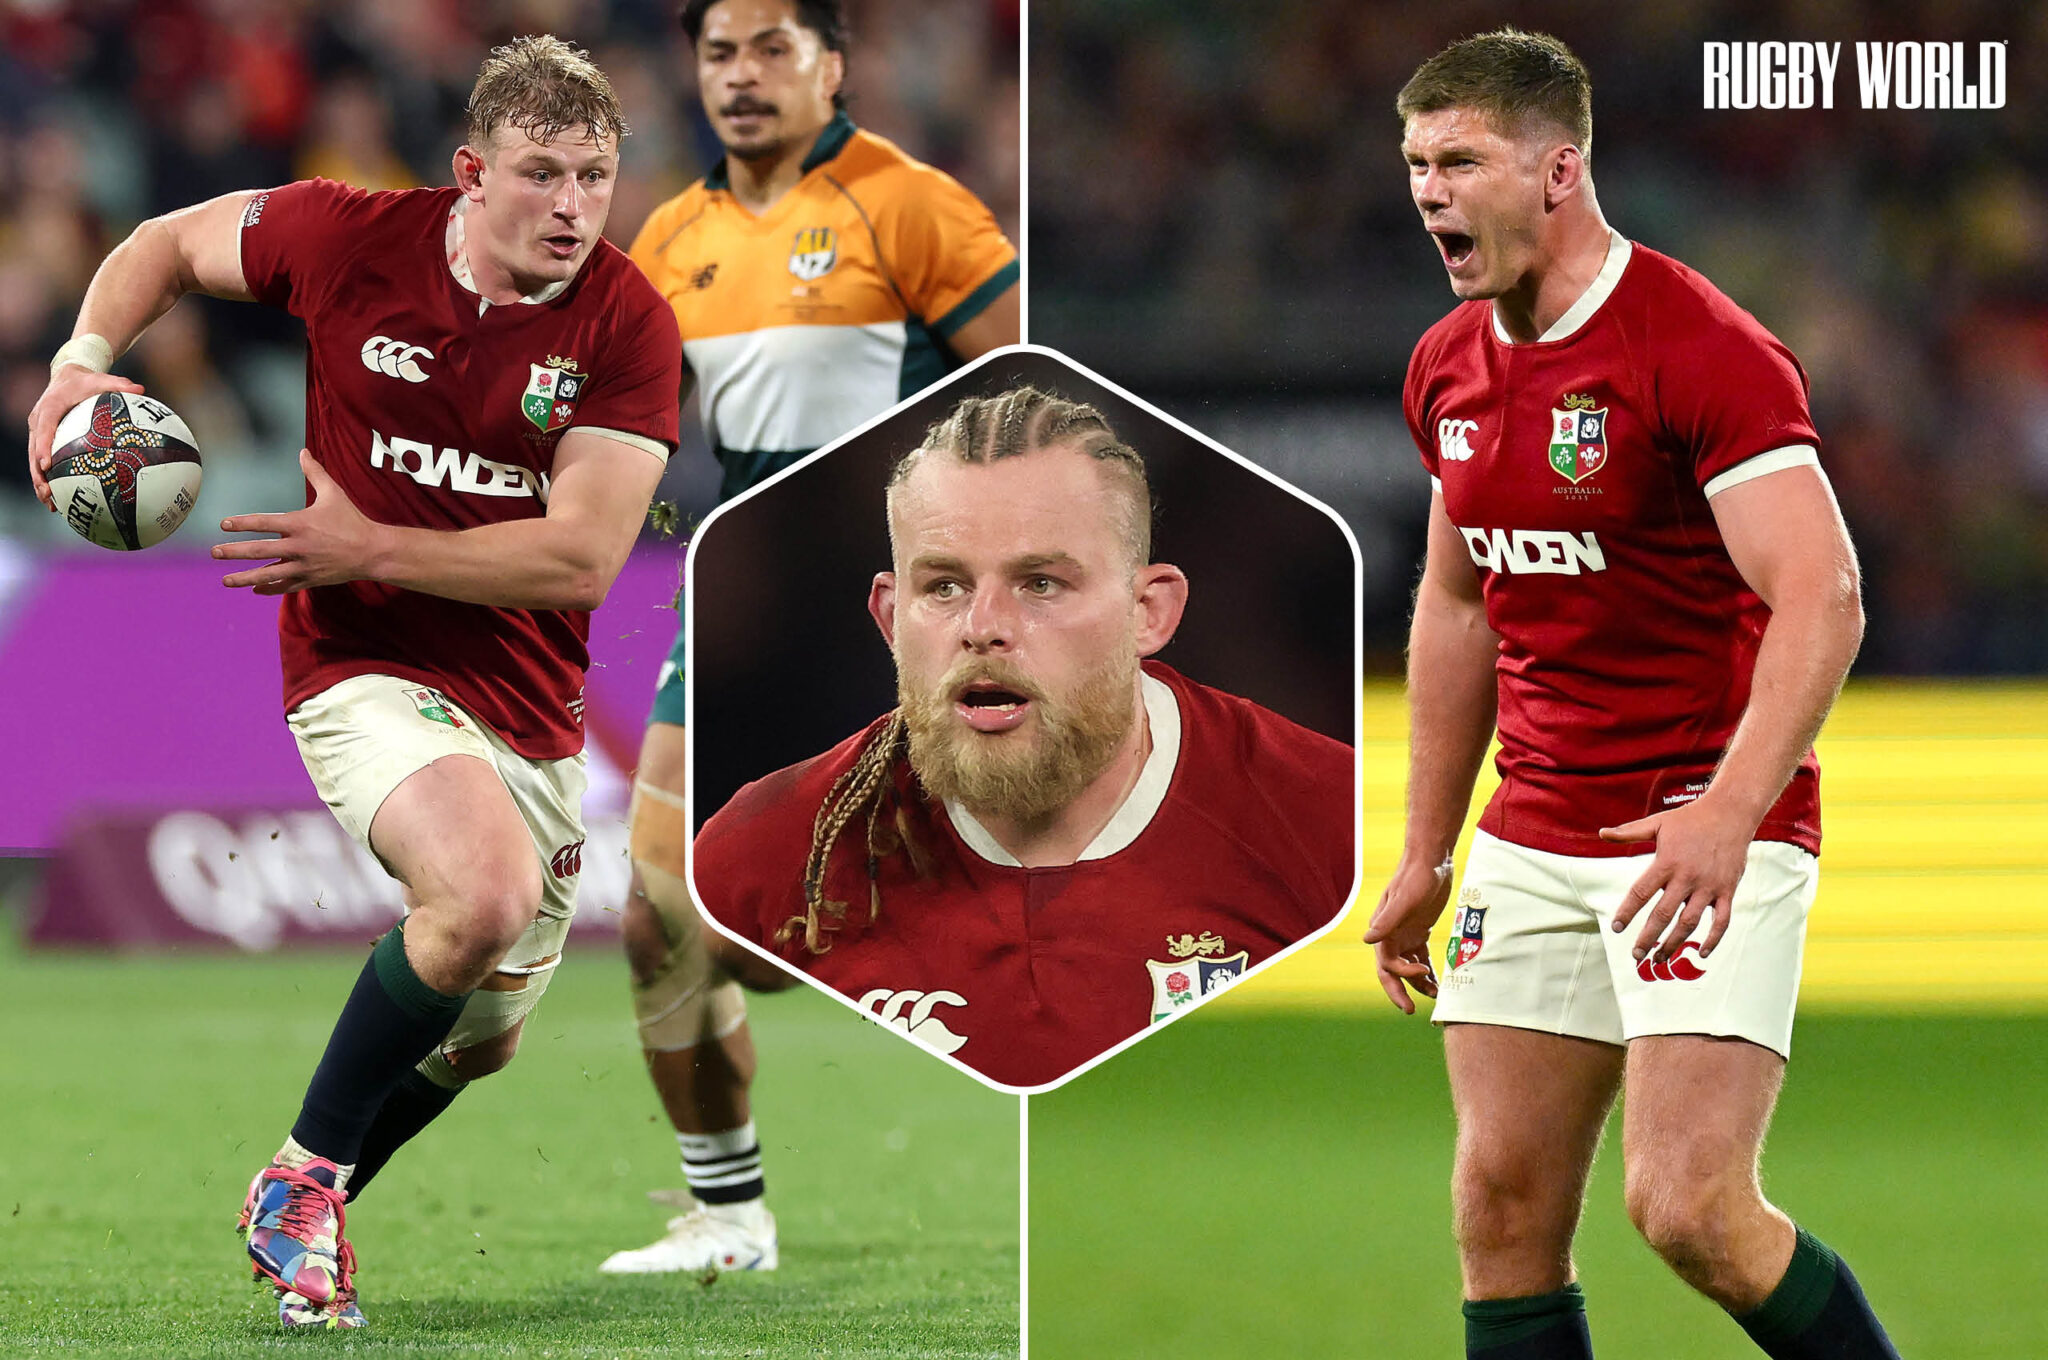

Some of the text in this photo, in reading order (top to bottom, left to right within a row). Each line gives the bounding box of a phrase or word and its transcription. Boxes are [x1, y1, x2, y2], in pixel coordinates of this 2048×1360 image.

[370, 428, 550, 506] HOWDEN
[1552, 486, 1603, 494] AUSTRALIA
[1454, 525, 1607, 576] OWDEN
